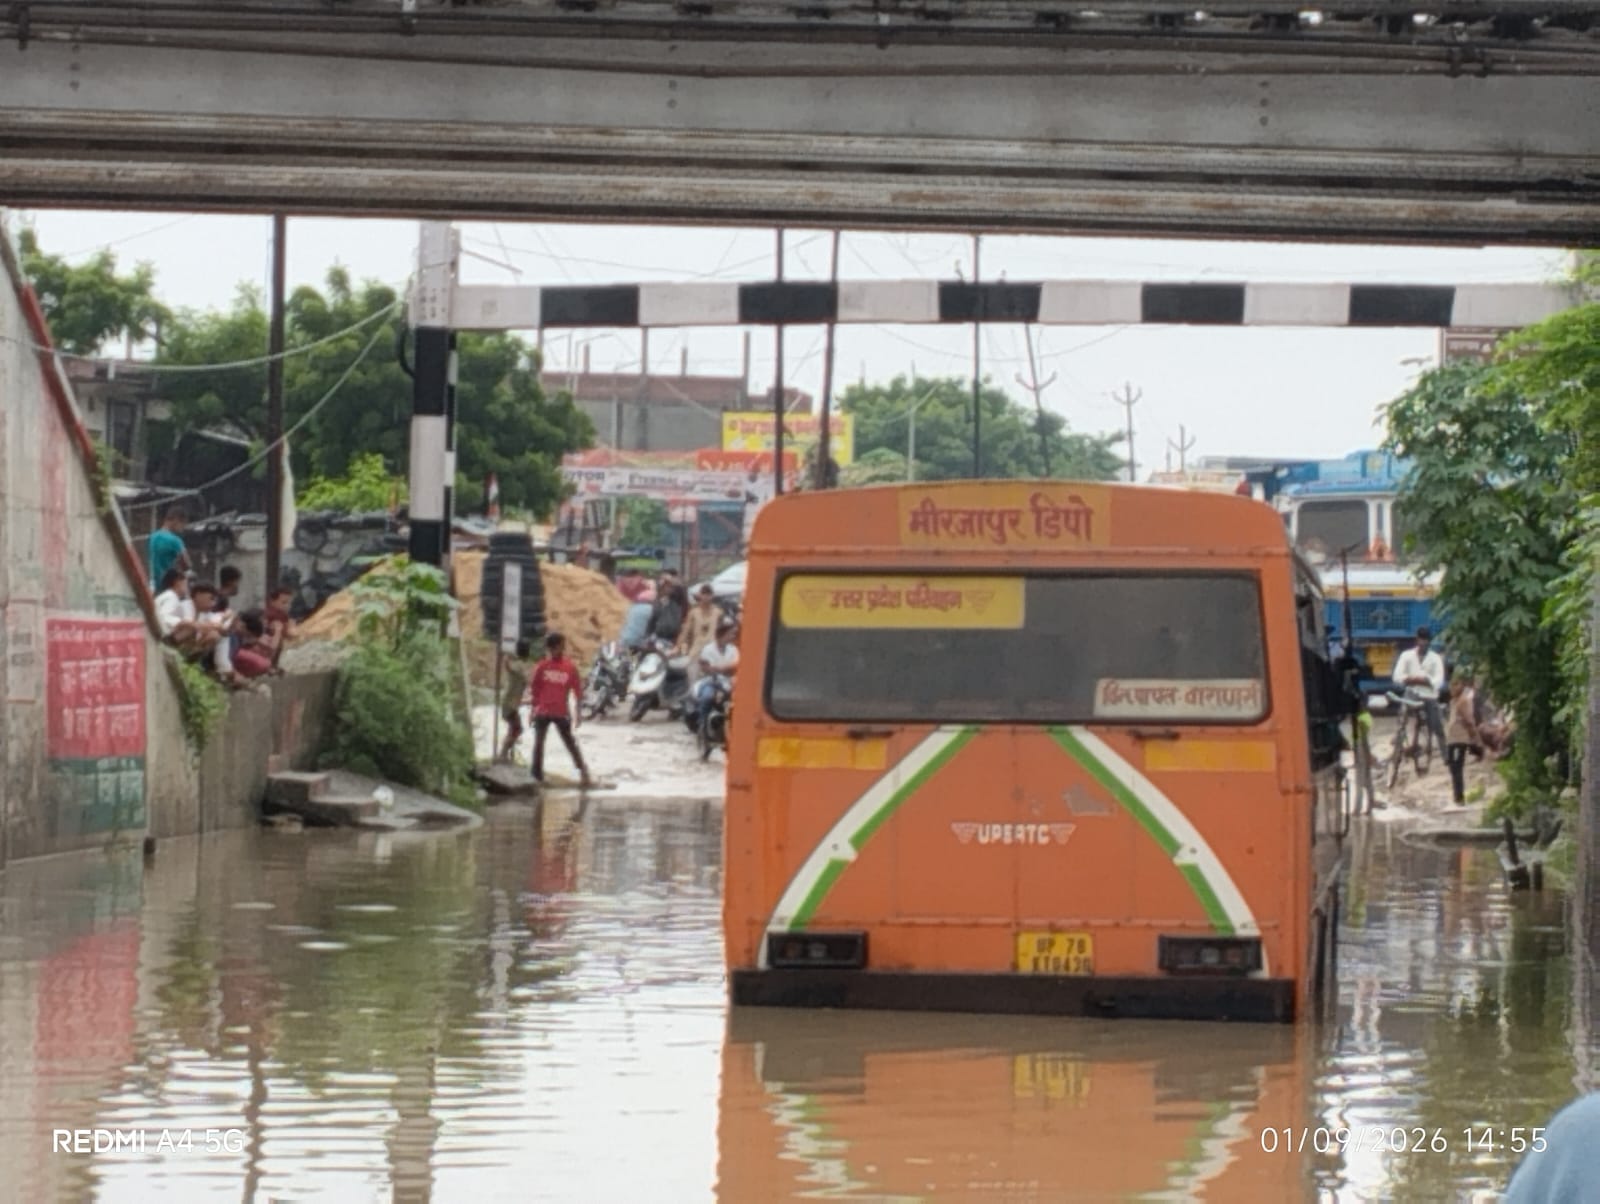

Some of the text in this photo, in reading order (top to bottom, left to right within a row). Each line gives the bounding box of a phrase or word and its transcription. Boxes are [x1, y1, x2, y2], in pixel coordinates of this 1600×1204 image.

[909, 492, 1094, 545] मीरजापुर डिपो
[1036, 937, 1056, 954] UP
